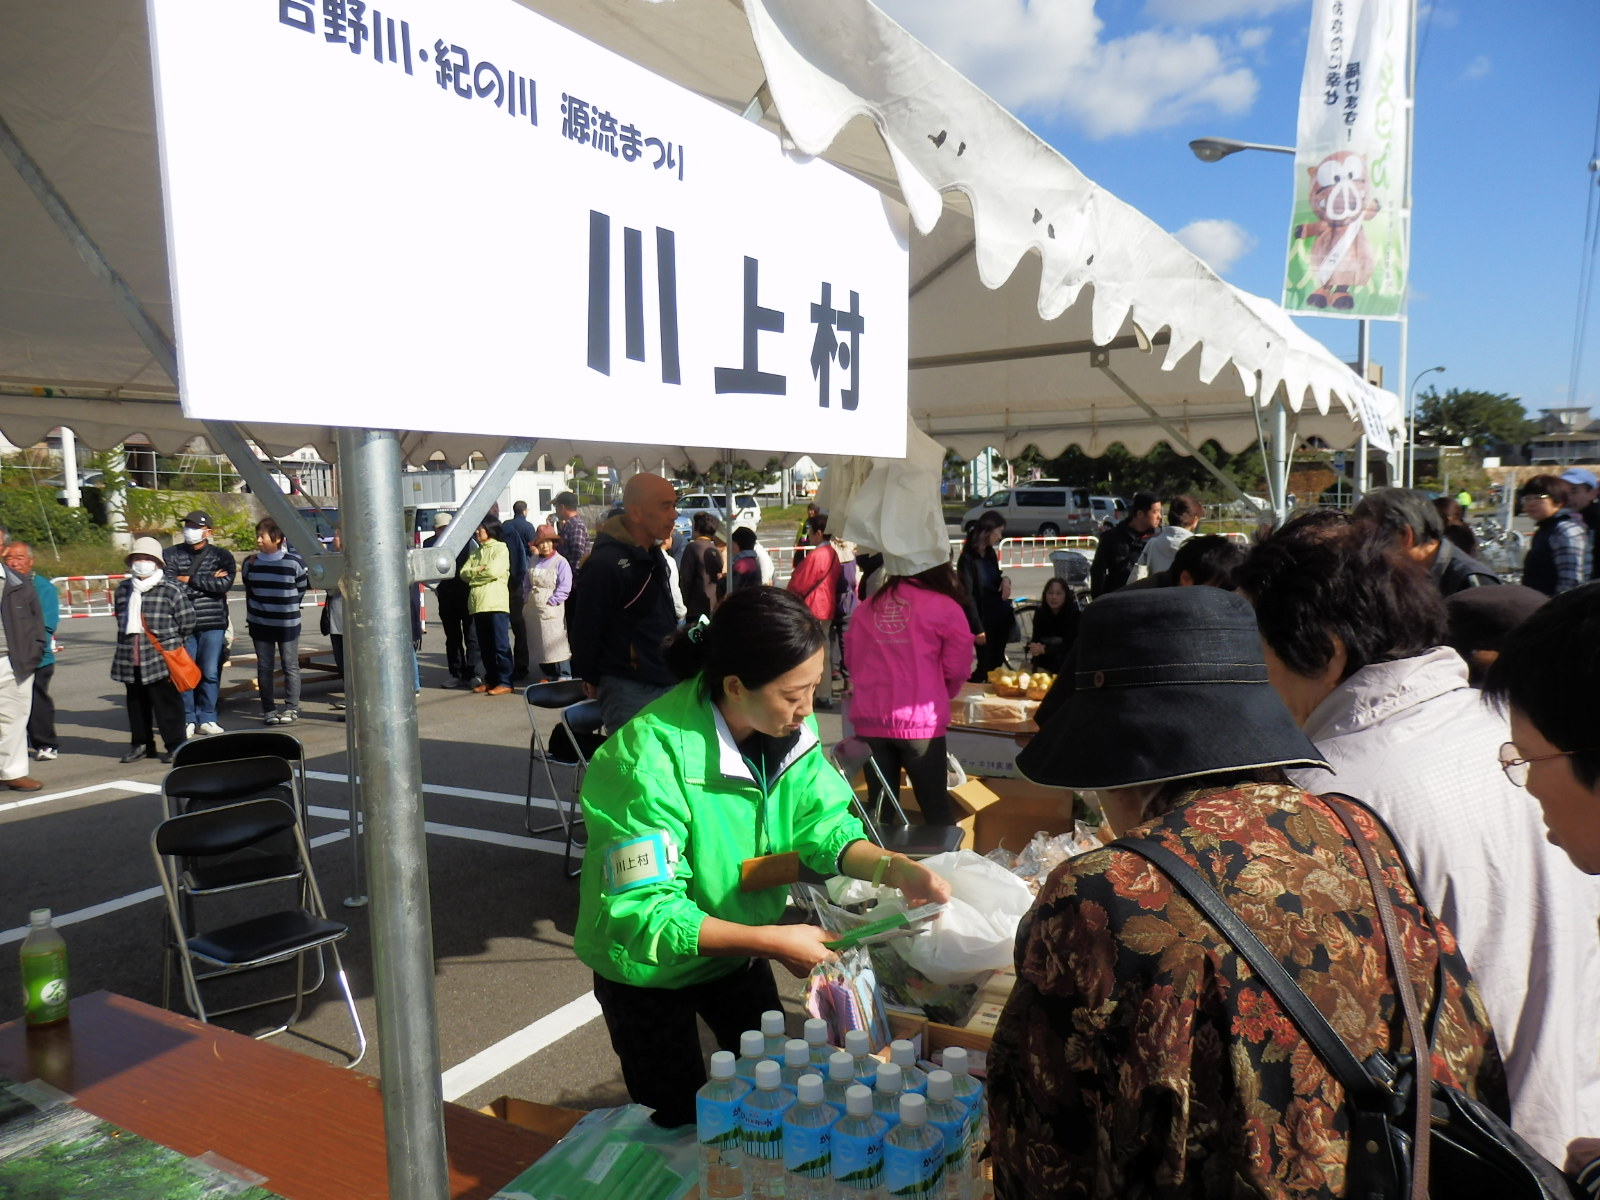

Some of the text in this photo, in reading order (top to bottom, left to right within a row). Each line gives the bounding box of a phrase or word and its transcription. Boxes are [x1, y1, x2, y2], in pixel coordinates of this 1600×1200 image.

[560, 92, 685, 181] 源流まつり
[587, 209, 865, 411] 川上村
[616, 853, 649, 875] 川上村
